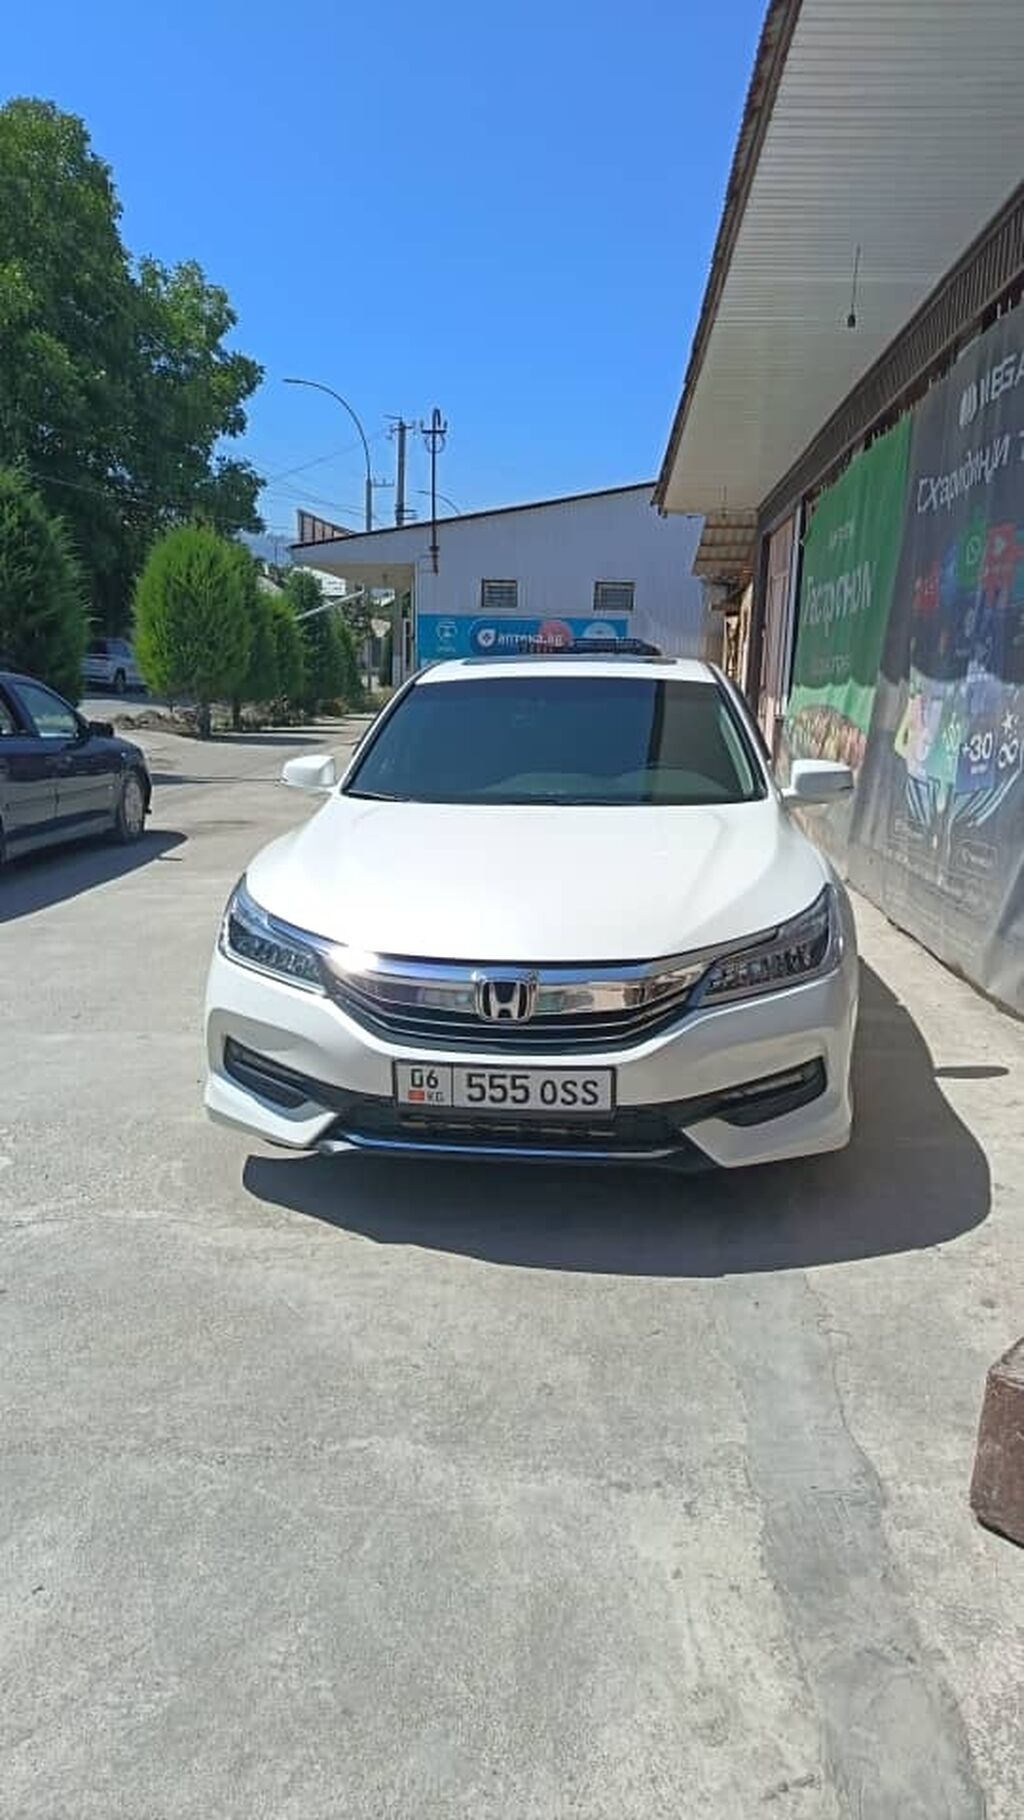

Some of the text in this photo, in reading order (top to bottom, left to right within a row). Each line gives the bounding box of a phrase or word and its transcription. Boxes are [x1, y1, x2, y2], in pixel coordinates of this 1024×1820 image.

[411, 1068, 599, 1105] 06 555 OSS
[428, 1091, 444, 1102] KG
